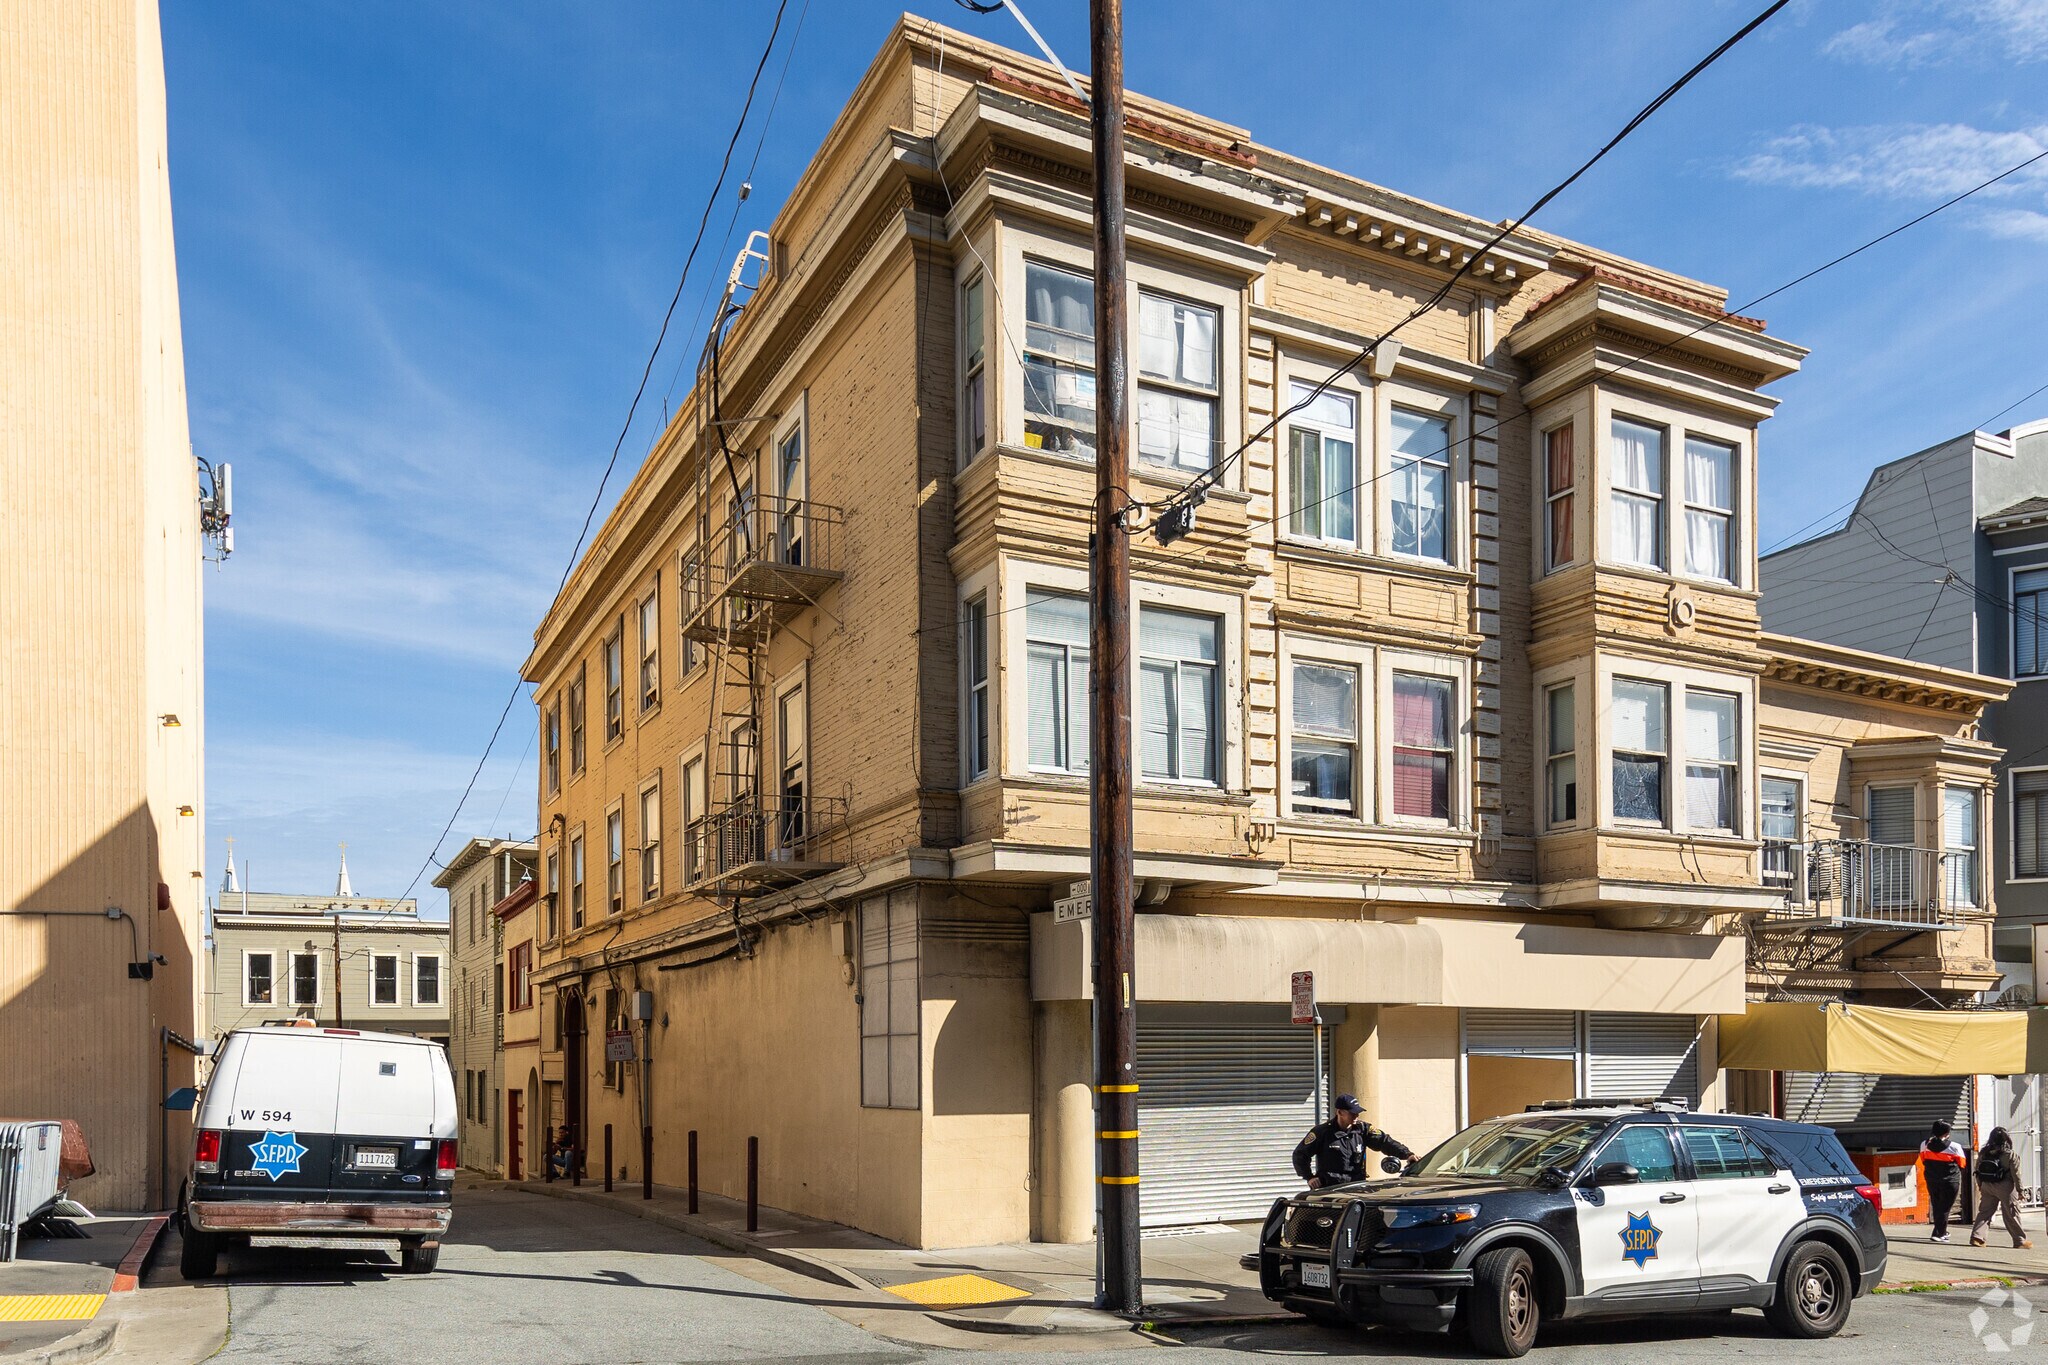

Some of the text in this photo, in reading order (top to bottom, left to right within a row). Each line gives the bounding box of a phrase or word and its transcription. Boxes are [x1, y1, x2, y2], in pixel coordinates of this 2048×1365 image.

[241, 1110, 291, 1122] W 594
[1798, 1177, 1839, 1185] EMERGENCY
